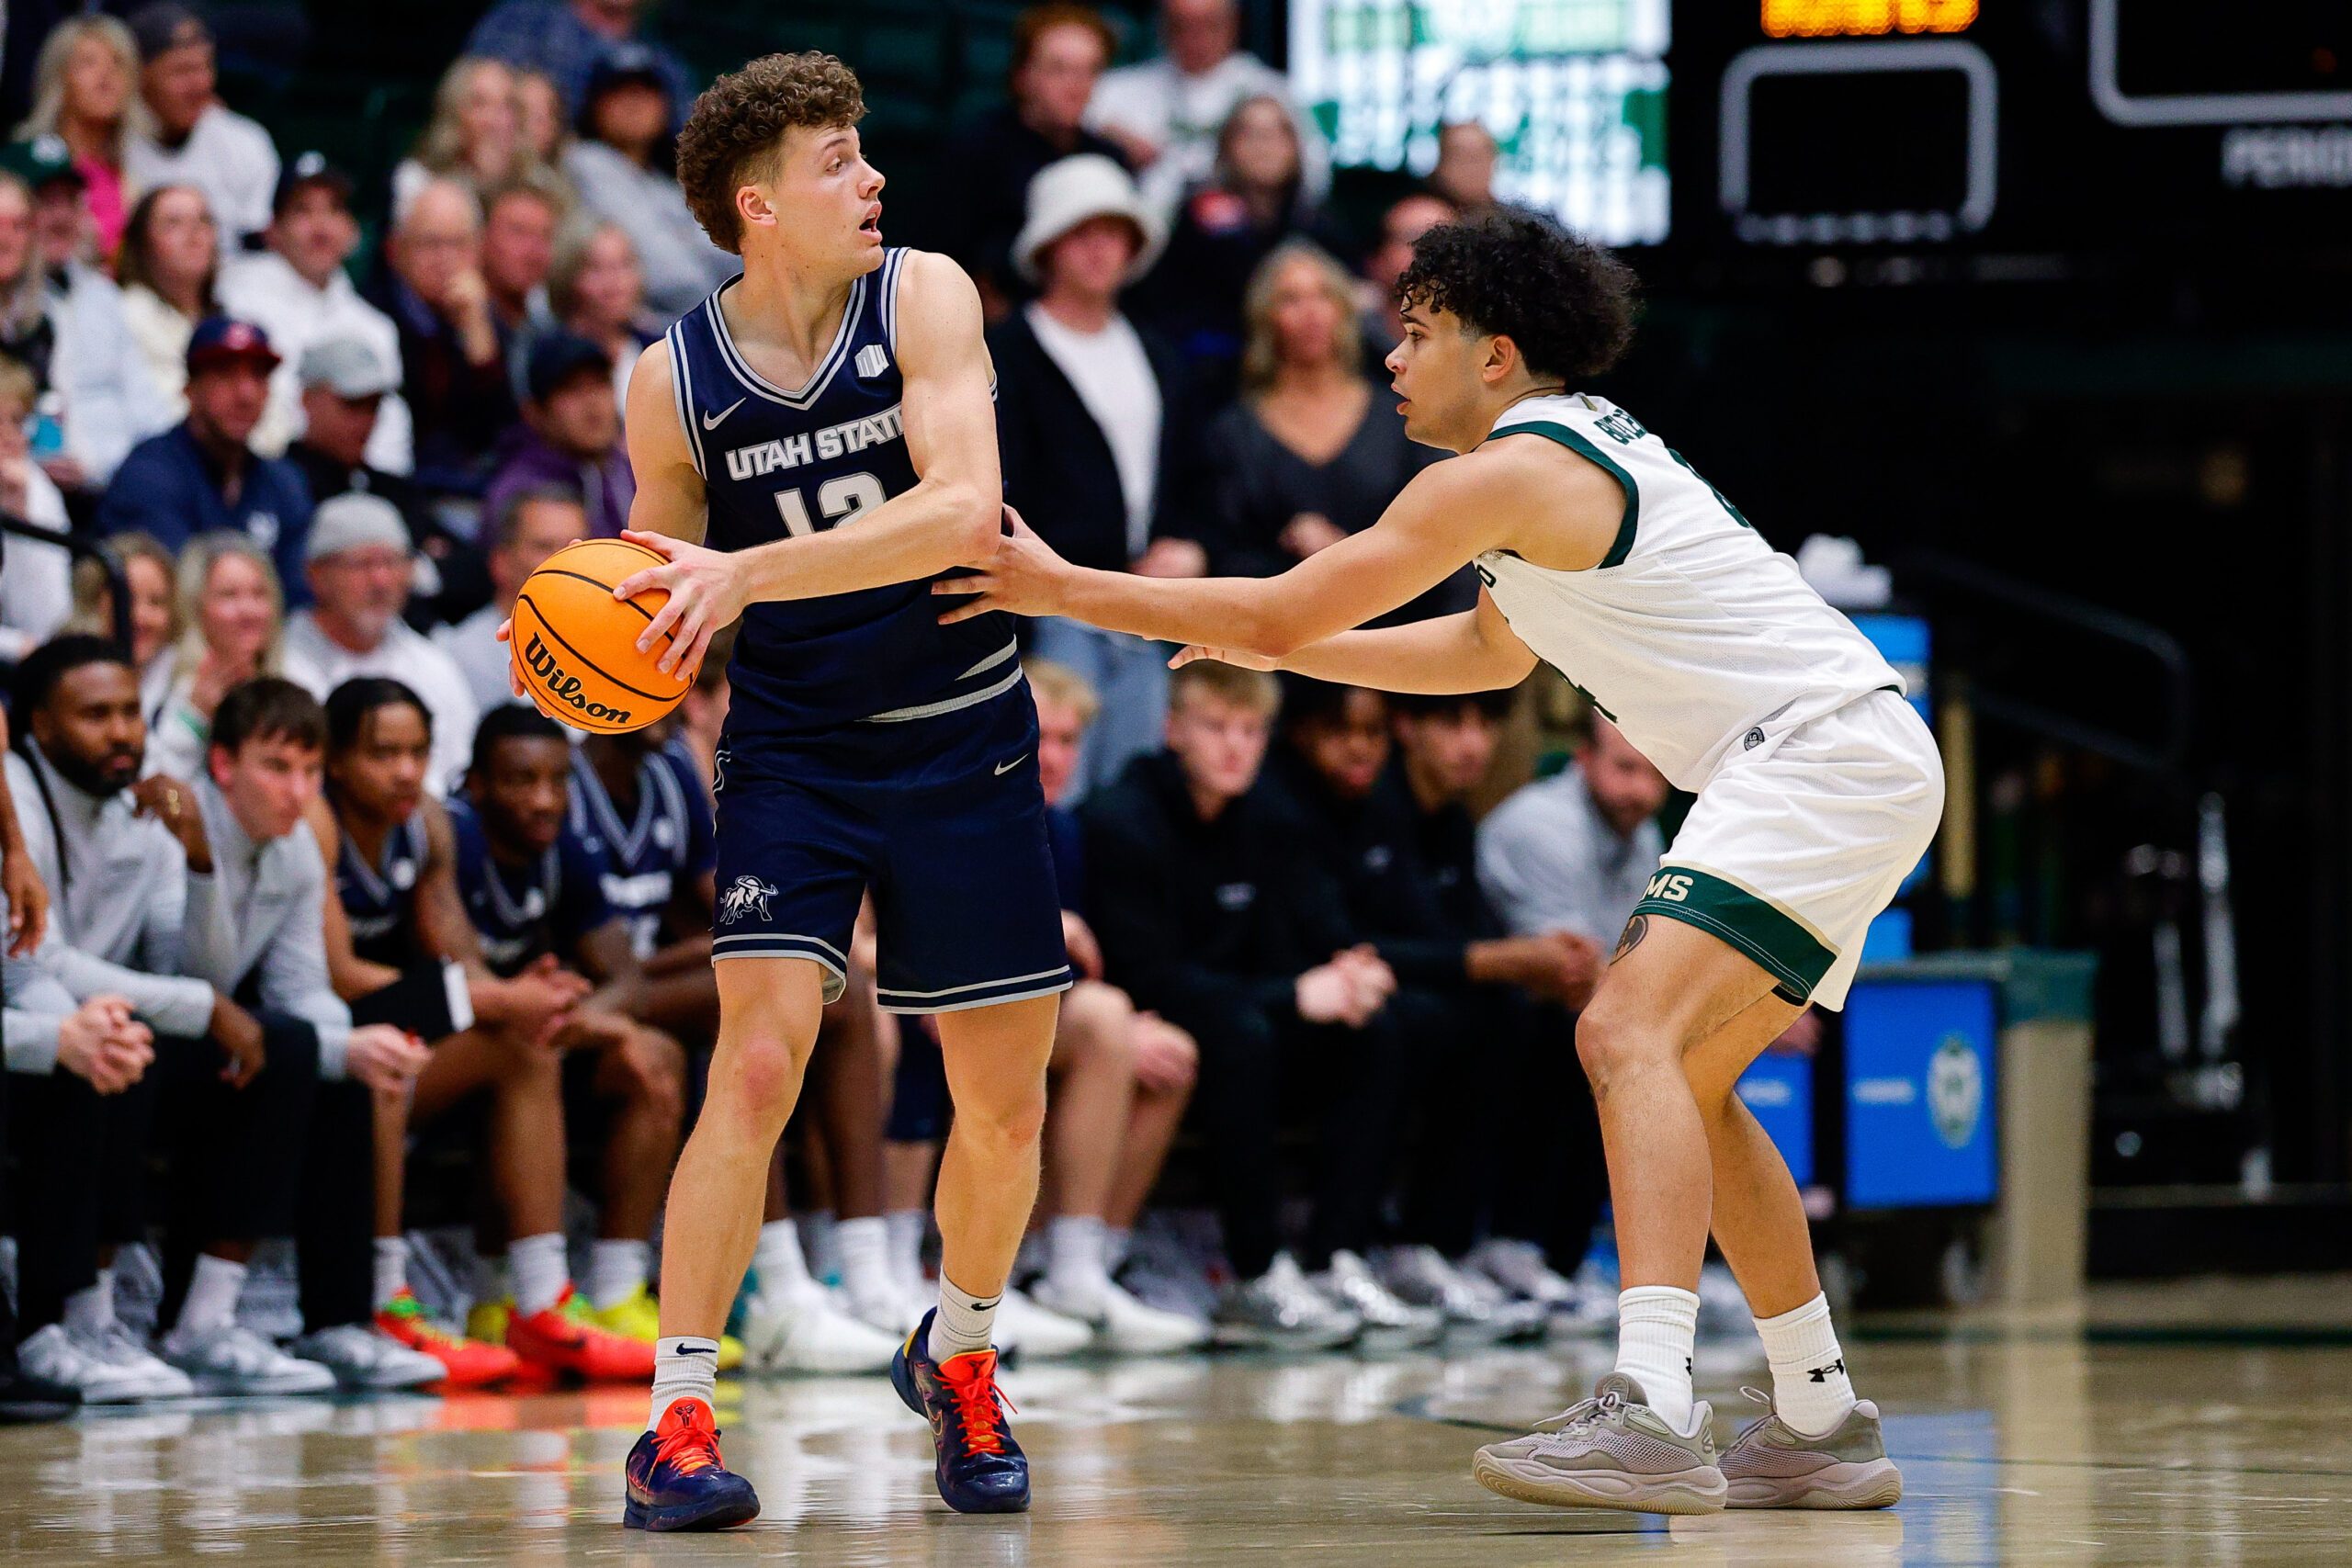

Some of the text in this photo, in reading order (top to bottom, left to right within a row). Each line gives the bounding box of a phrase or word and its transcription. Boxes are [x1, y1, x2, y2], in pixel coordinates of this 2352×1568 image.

[725, 433, 813, 481] UTAH
[525, 631, 631, 724] Wilson
[1639, 874, 1693, 902] MS
